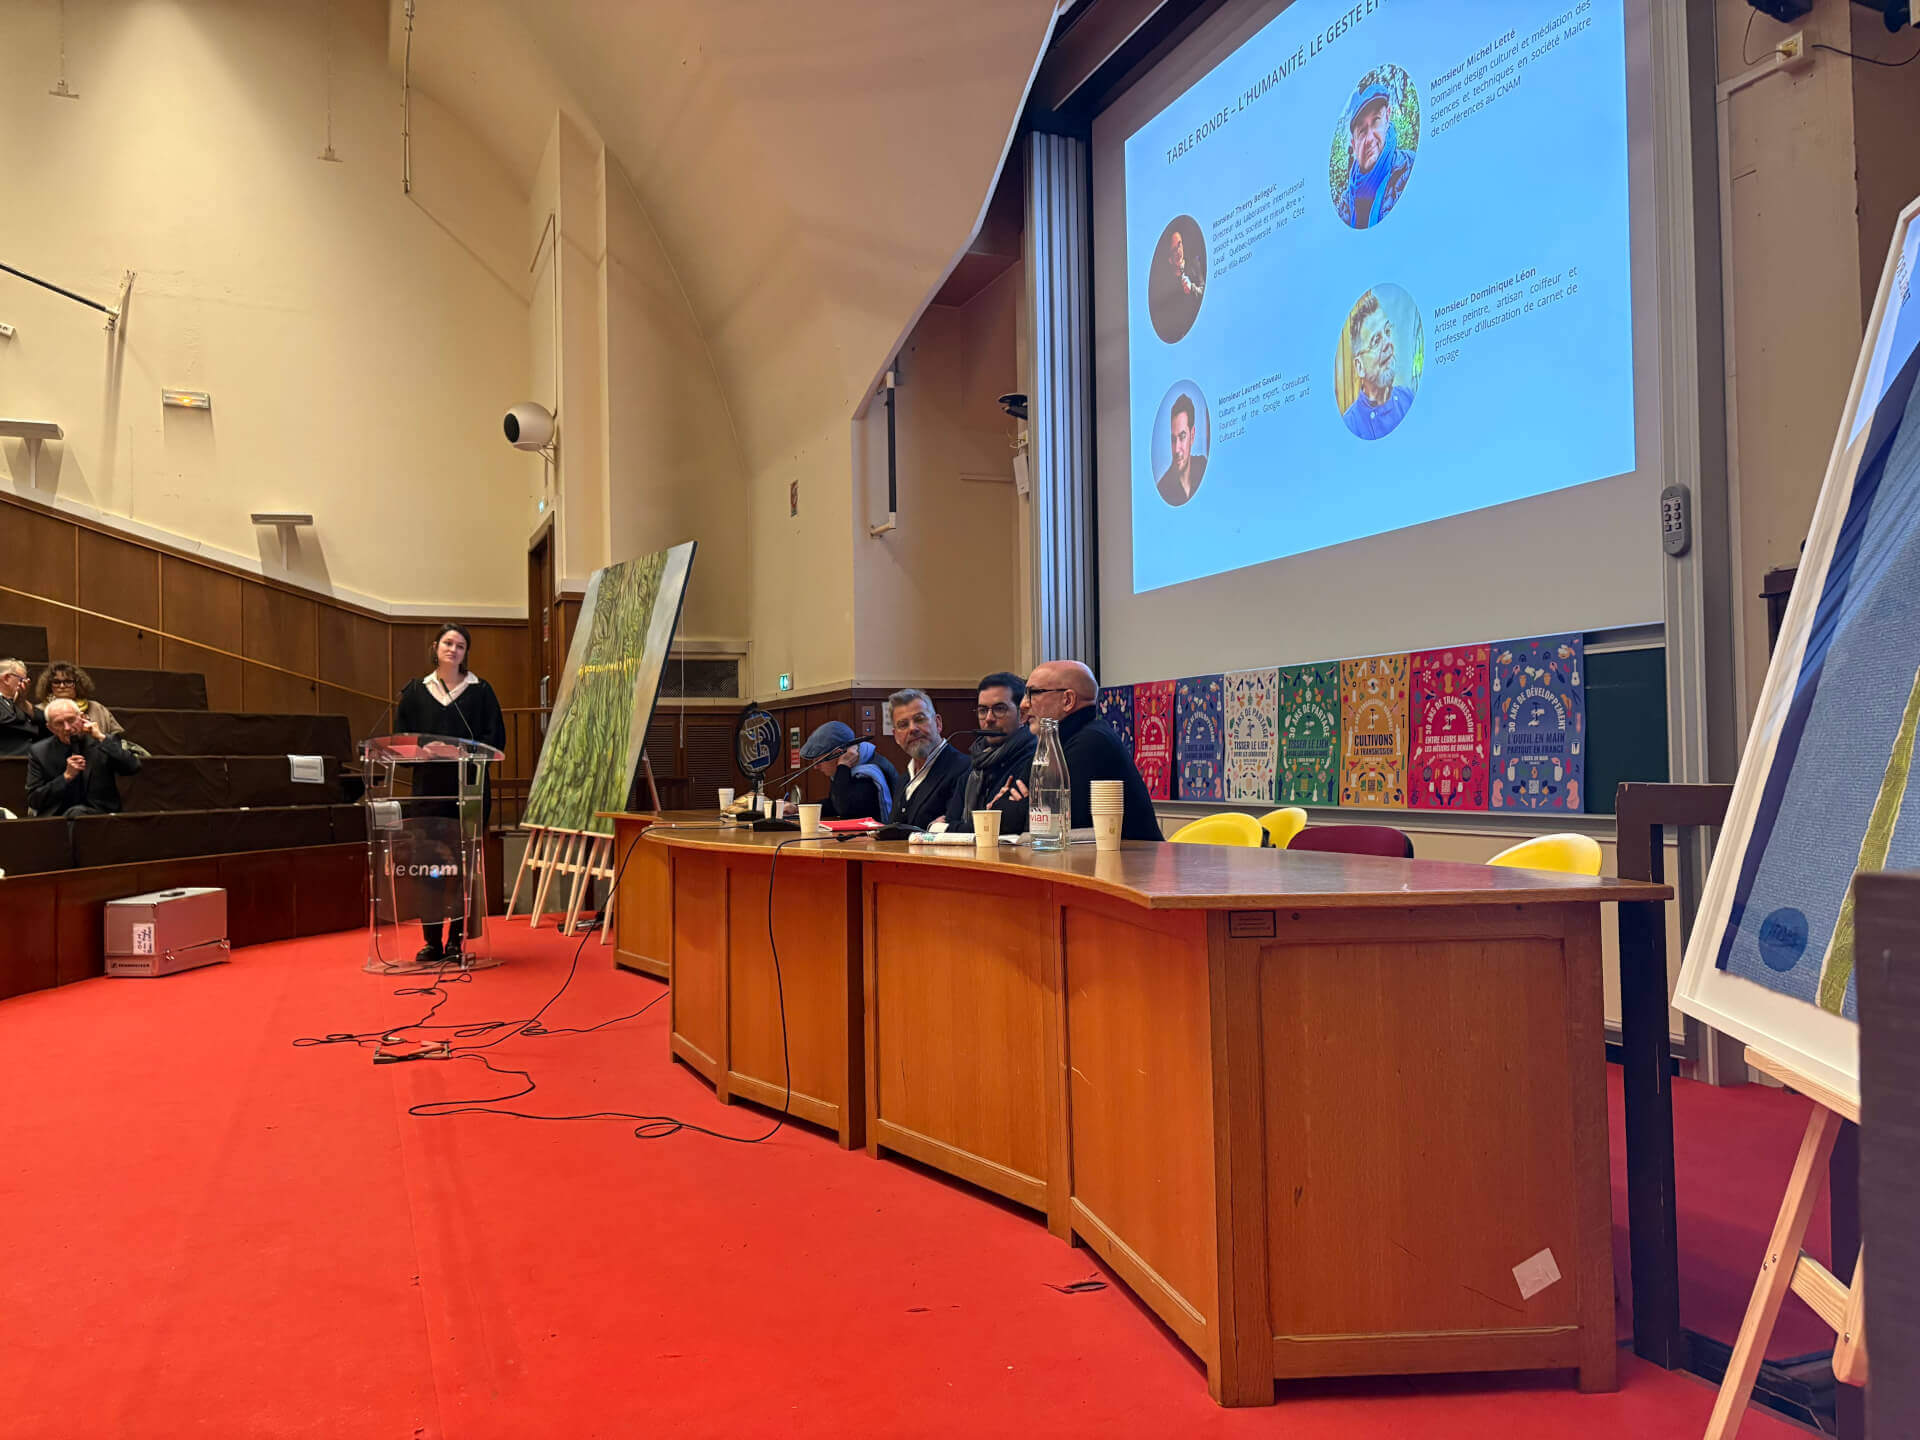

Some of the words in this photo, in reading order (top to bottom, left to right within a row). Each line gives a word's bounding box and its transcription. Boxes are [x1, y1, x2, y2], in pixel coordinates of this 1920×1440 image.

[1430, 81, 1462, 107] Domaine
[1463, 64, 1488, 87] design
[1490, 42, 1519, 70] culturel
[1521, 37, 1530, 49] et
[1531, 10, 1573, 44] médiation
[1575, 0, 1592, 16] des
[1430, 61, 1466, 91] Monsieur
[1466, 41, 1493, 68] Michel
[1494, 28, 1516, 50] Letté
[1166, 133, 1194, 165] TABLE
[1196, 106, 1230, 143] RONDE
[1238, 45, 1308, 111] L'HUMANITÉ,
[1310, 34, 1323, 58] LE
[1326, 3, 1363, 44] GESTE
[1430, 98, 1460, 123] sciences
[1462, 91, 1471, 103] et
[1473, 63, 1515, 96] techniques
[1517, 56, 1528, 69] en
[1531, 33, 1561, 61] société
[1430, 126, 1440, 138] de
[1441, 100, 1485, 132] conférences
[1485, 92, 1496, 106] au
[1496, 75, 1522, 99] CNAM
[1434, 296, 1469, 319] Monsieur
[1470, 277, 1514, 304] Dominique
[1515, 267, 1536, 284] Léon
[1434, 317, 1457, 335] Artiste
[1496, 290, 1524, 309] artisan
[1529, 272, 1561, 295] coiffeur
[1568, 266, 1578, 278] et
[1434, 326, 1473, 352] professeur
[1474, 306, 1521, 333] d'illustration
[1523, 301, 1534, 314] de
[1536, 289, 1564, 308] carnet
[1566, 283, 1578, 296] de
[1434, 348, 1460, 366] voyage
[1241, 381, 1261, 396] Laurent
[1244, 707, 1252, 717] DE
[1252, 707, 1269, 739] PARTAGE
[1291, 708, 1303, 726] ANS
[1302, 703, 1311, 714] DE
[1311, 703, 1330, 737] PARTAGE
[1426, 706, 1437, 723] ANS
[1434, 698, 1443, 710] DE
[1443, 695, 1474, 733] TRANSMISSION
[1509, 702, 1520, 720] ANS
[1516, 691, 1526, 705] DE
[1525, 685, 1566, 731] DÉVELOPPEMENT
[1234, 741, 1250, 750] TISSER
[1250, 741, 1257, 750] LE
[1257, 741, 1269, 750] LIEN
[1354, 733, 1393, 747] CULTIVONS
[1425, 735, 1441, 744] ENTRE
[1535, 734, 1544, 744] EN
[1546, 731, 1565, 744] MAIN
[408, 863, 459, 878] cnam
